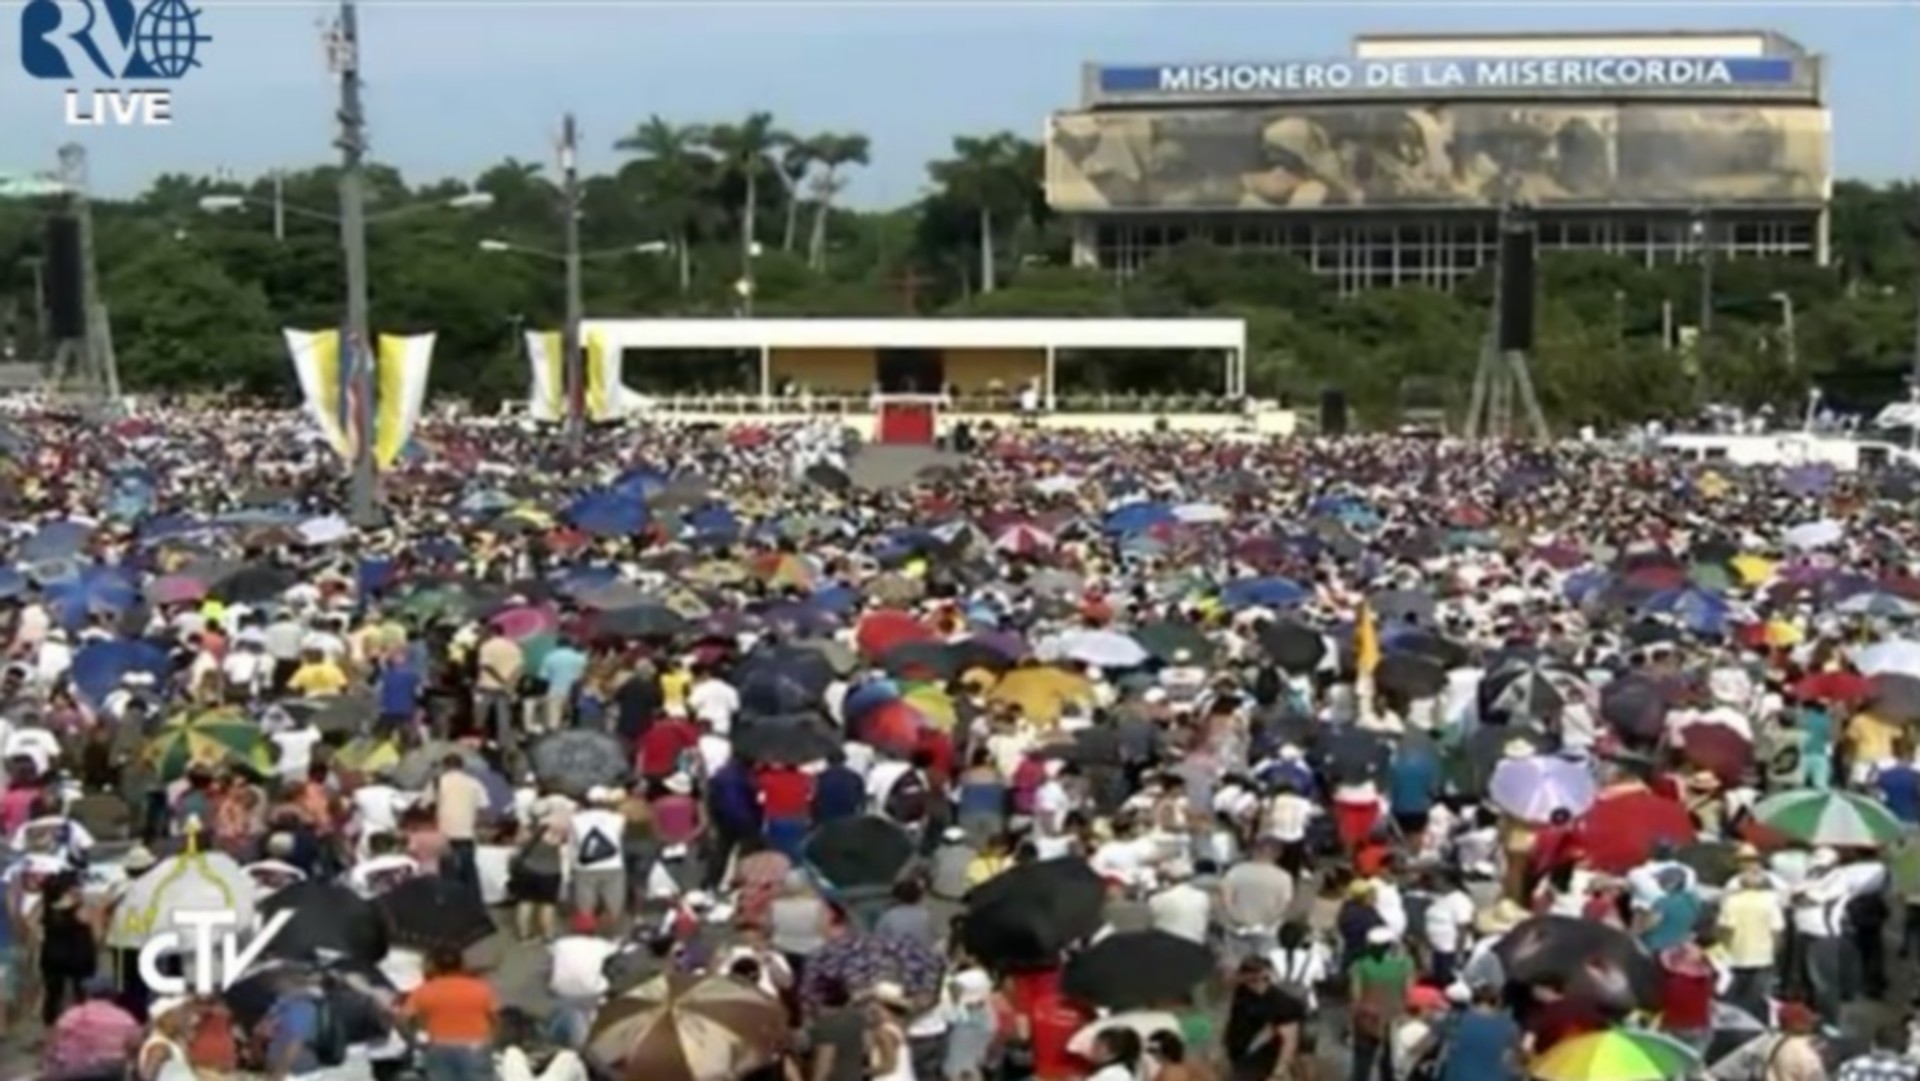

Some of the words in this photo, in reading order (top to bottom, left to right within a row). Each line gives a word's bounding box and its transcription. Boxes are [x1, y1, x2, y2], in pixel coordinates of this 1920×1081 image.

[1159, 63, 1351, 91] MISIONERO
[1366, 62, 1405, 87] DE
[1422, 61, 1465, 86] LA
[1476, 58, 1732, 86] MISERICORDIA
